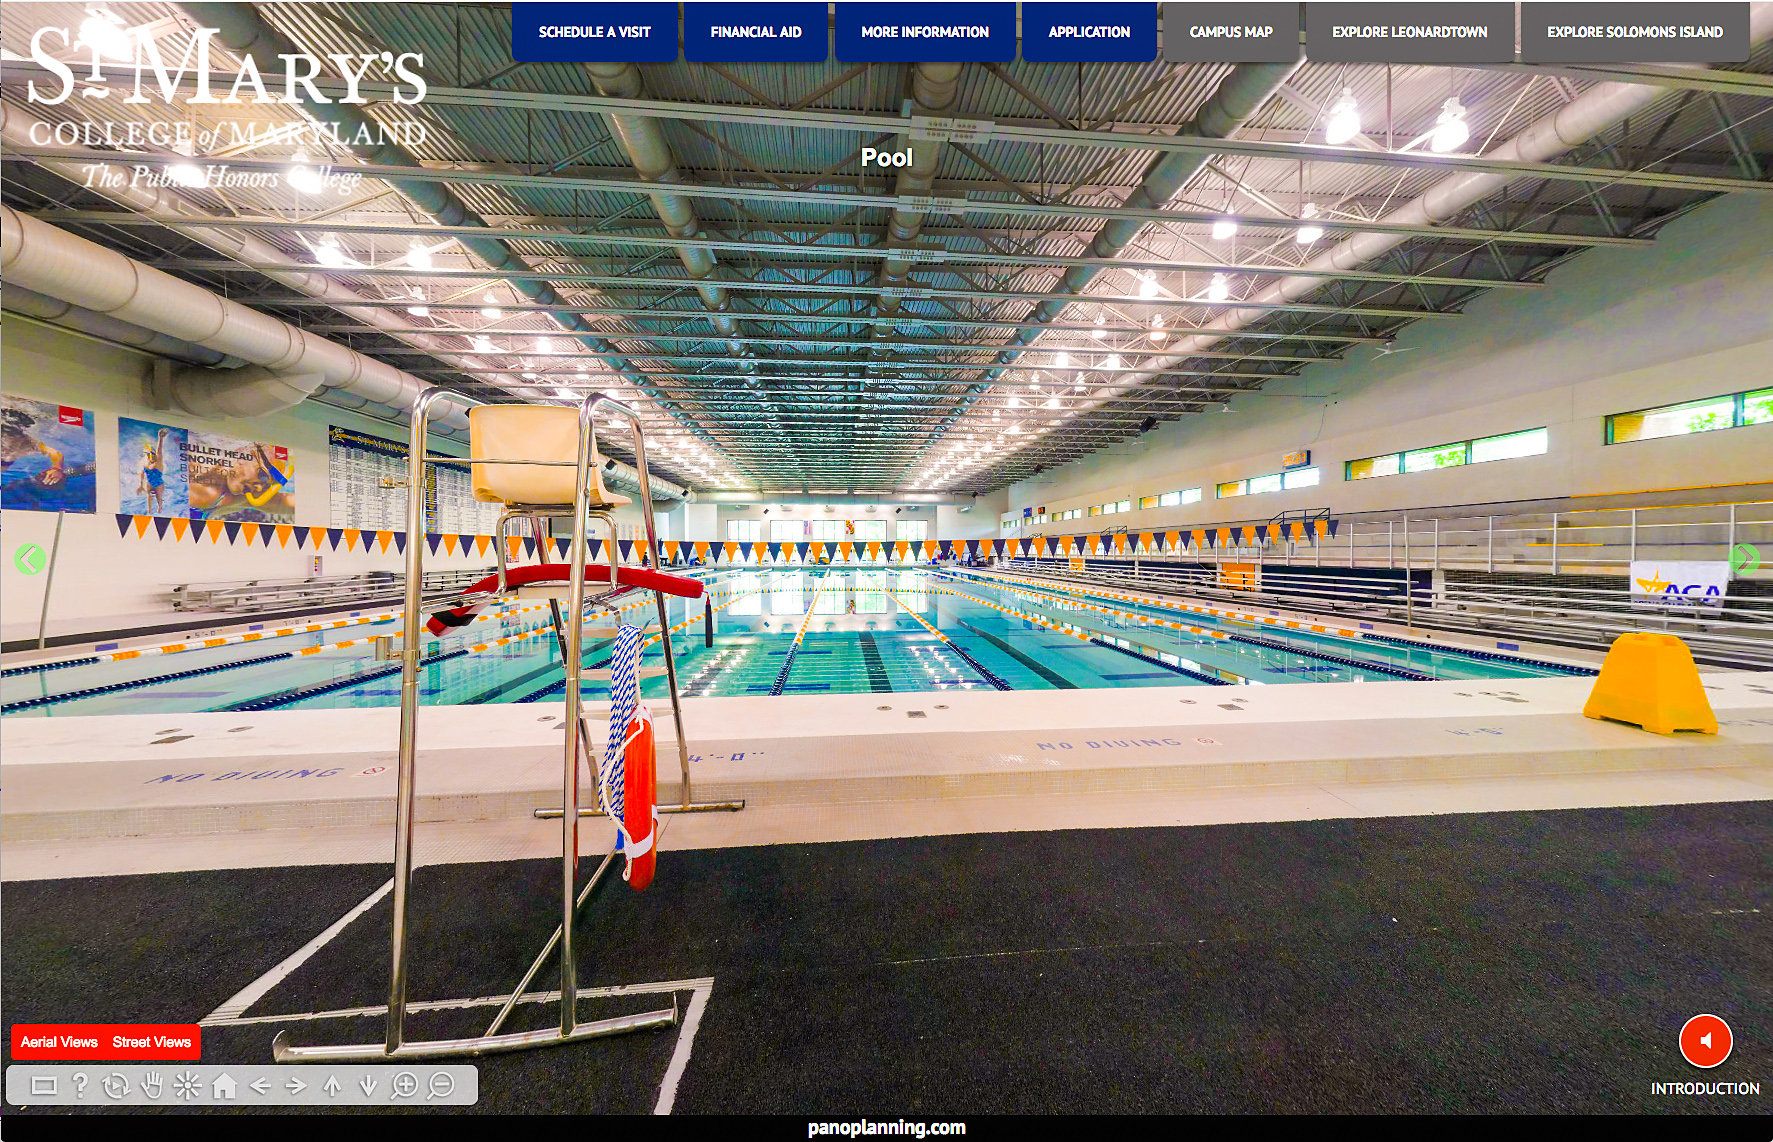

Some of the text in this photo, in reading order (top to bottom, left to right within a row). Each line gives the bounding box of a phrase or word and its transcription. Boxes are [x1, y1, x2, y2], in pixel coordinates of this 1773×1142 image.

[180, 442, 254, 462] BULLET HEAD
[180, 453, 235, 468] SNORKEL
[180, 463, 210, 475] BUILT
[1036, 741, 1074, 751] NO
[144, 772, 205, 785] NO
